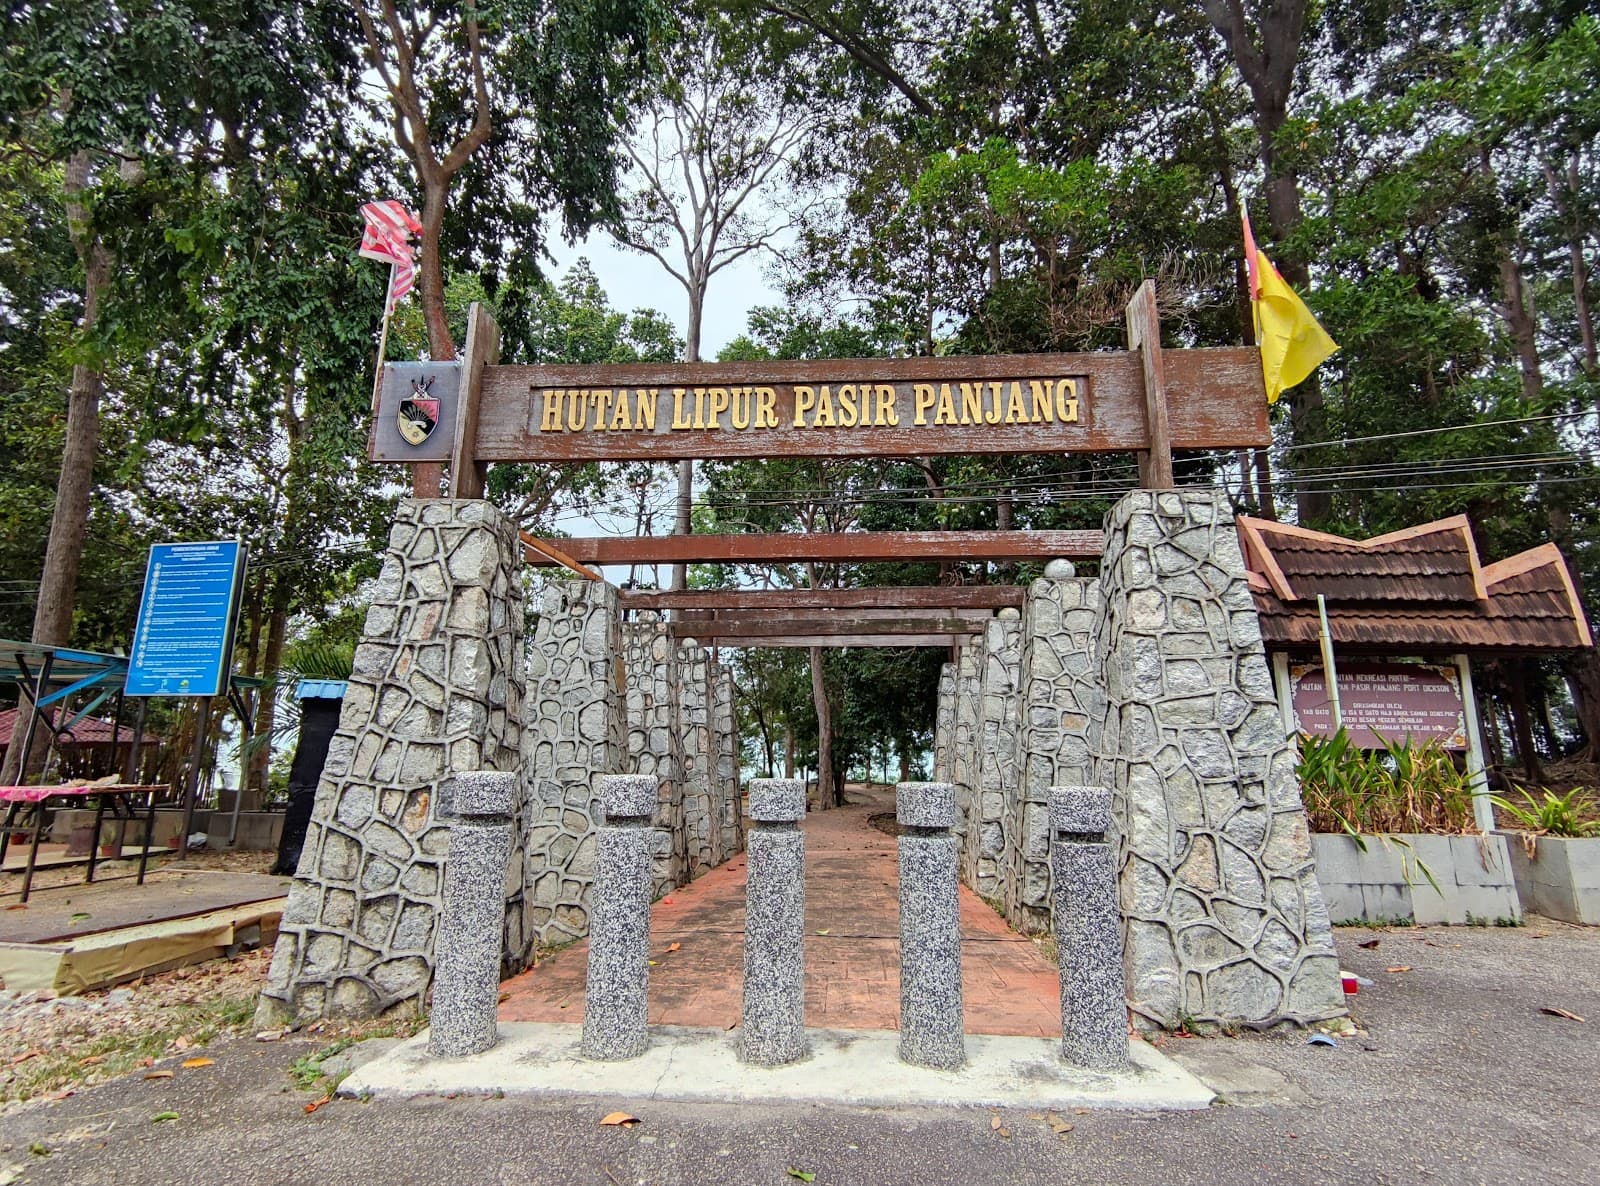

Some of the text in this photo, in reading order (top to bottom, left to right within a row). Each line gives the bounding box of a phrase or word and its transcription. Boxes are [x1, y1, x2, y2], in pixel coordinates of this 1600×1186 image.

[540, 378, 1079, 431] HUTAN LIPUR PASIR PANJANG
[1301, 683, 1322, 691] HUTAN
[1351, 683, 1370, 691] PASIR
[1373, 684, 1400, 692] PANJANG
[1403, 684, 1419, 692] PORT
